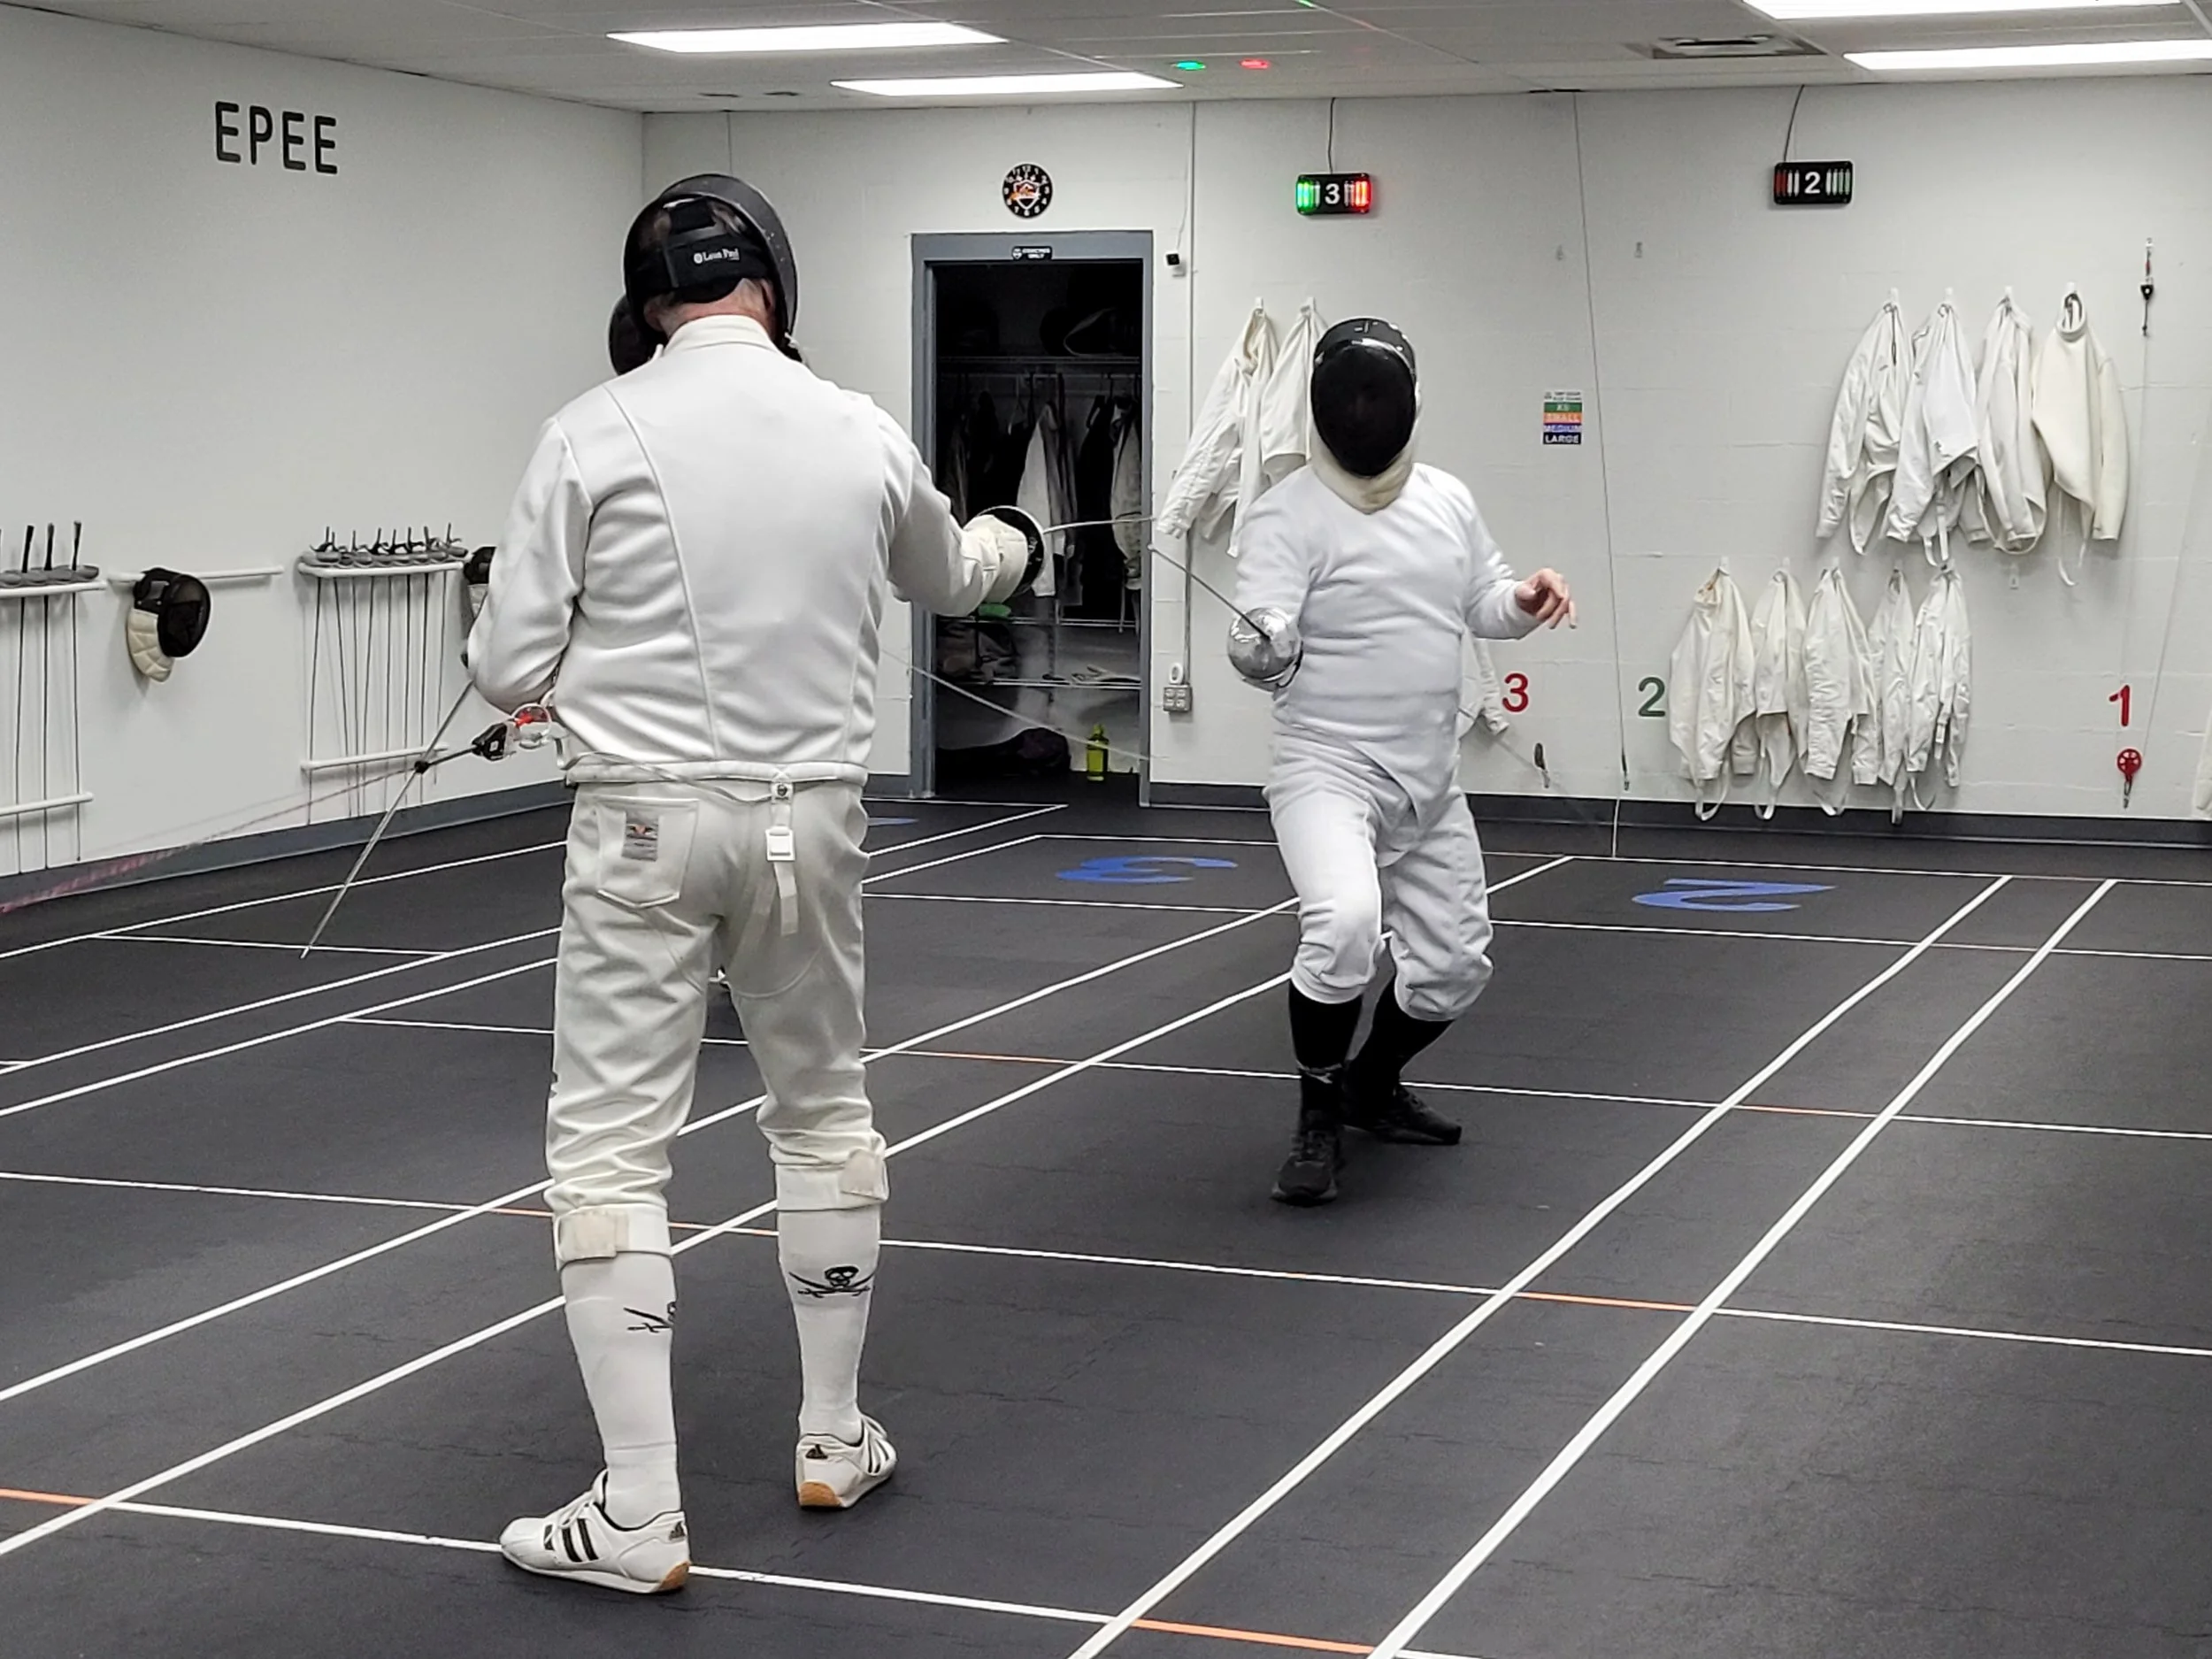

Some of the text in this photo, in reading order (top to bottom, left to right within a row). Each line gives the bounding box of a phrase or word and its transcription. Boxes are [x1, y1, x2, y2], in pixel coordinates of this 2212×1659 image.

[215, 101, 338, 174] EPEE
[1325, 183, 1340, 204] 3
[1804, 171, 1821, 194] 2
[1545, 434, 1579, 443] LARGE
[1502, 673, 1529, 712] 3
[1638, 677, 1665, 718] 2
[2108, 684, 2131, 727] 1
